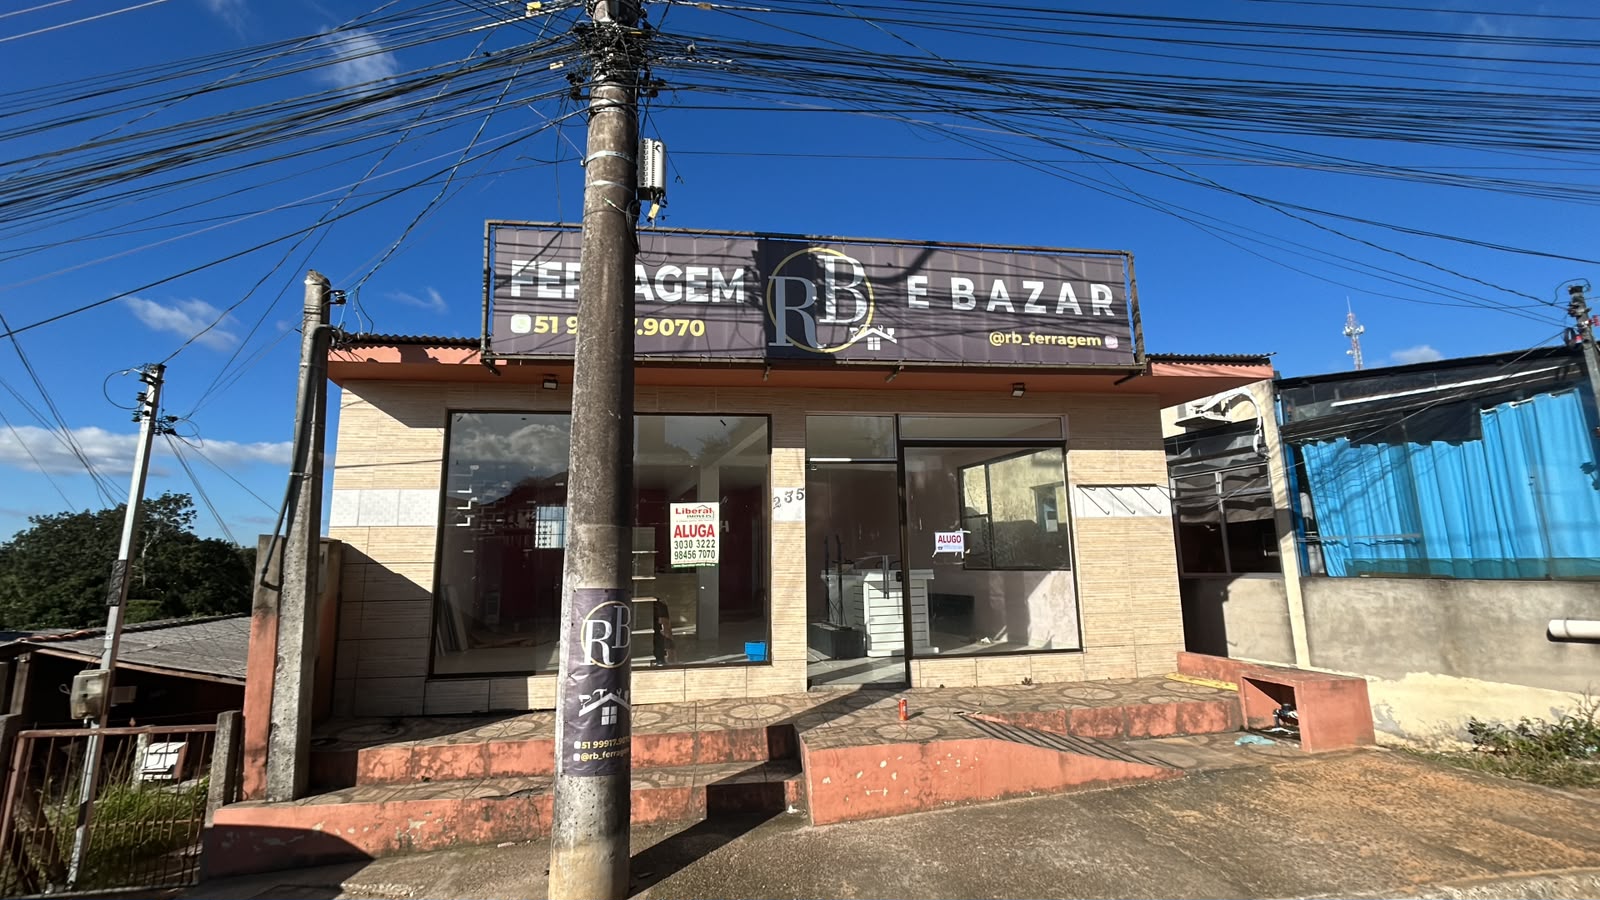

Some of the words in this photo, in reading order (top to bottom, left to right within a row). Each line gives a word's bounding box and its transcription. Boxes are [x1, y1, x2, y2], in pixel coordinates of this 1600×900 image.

[511, 259, 745, 304] FERAGEM
[906, 275, 930, 310] E
[950, 277, 1115, 316] BAZAR
[533, 314, 558, 333] 51
[989, 330, 1102, 349] @rb_ferragem
[773, 487, 805, 510] 235
[675, 507, 713, 515] Liberal
[673, 523, 715, 539] ALUGA
[937, 534, 962, 544] ALUGO
[674, 540, 693, 550] 3030
[695, 539, 716, 549] 3222
[673, 550, 697, 560] 98456
[698, 549, 716, 559] 7070
[581, 741, 591, 749] 51
